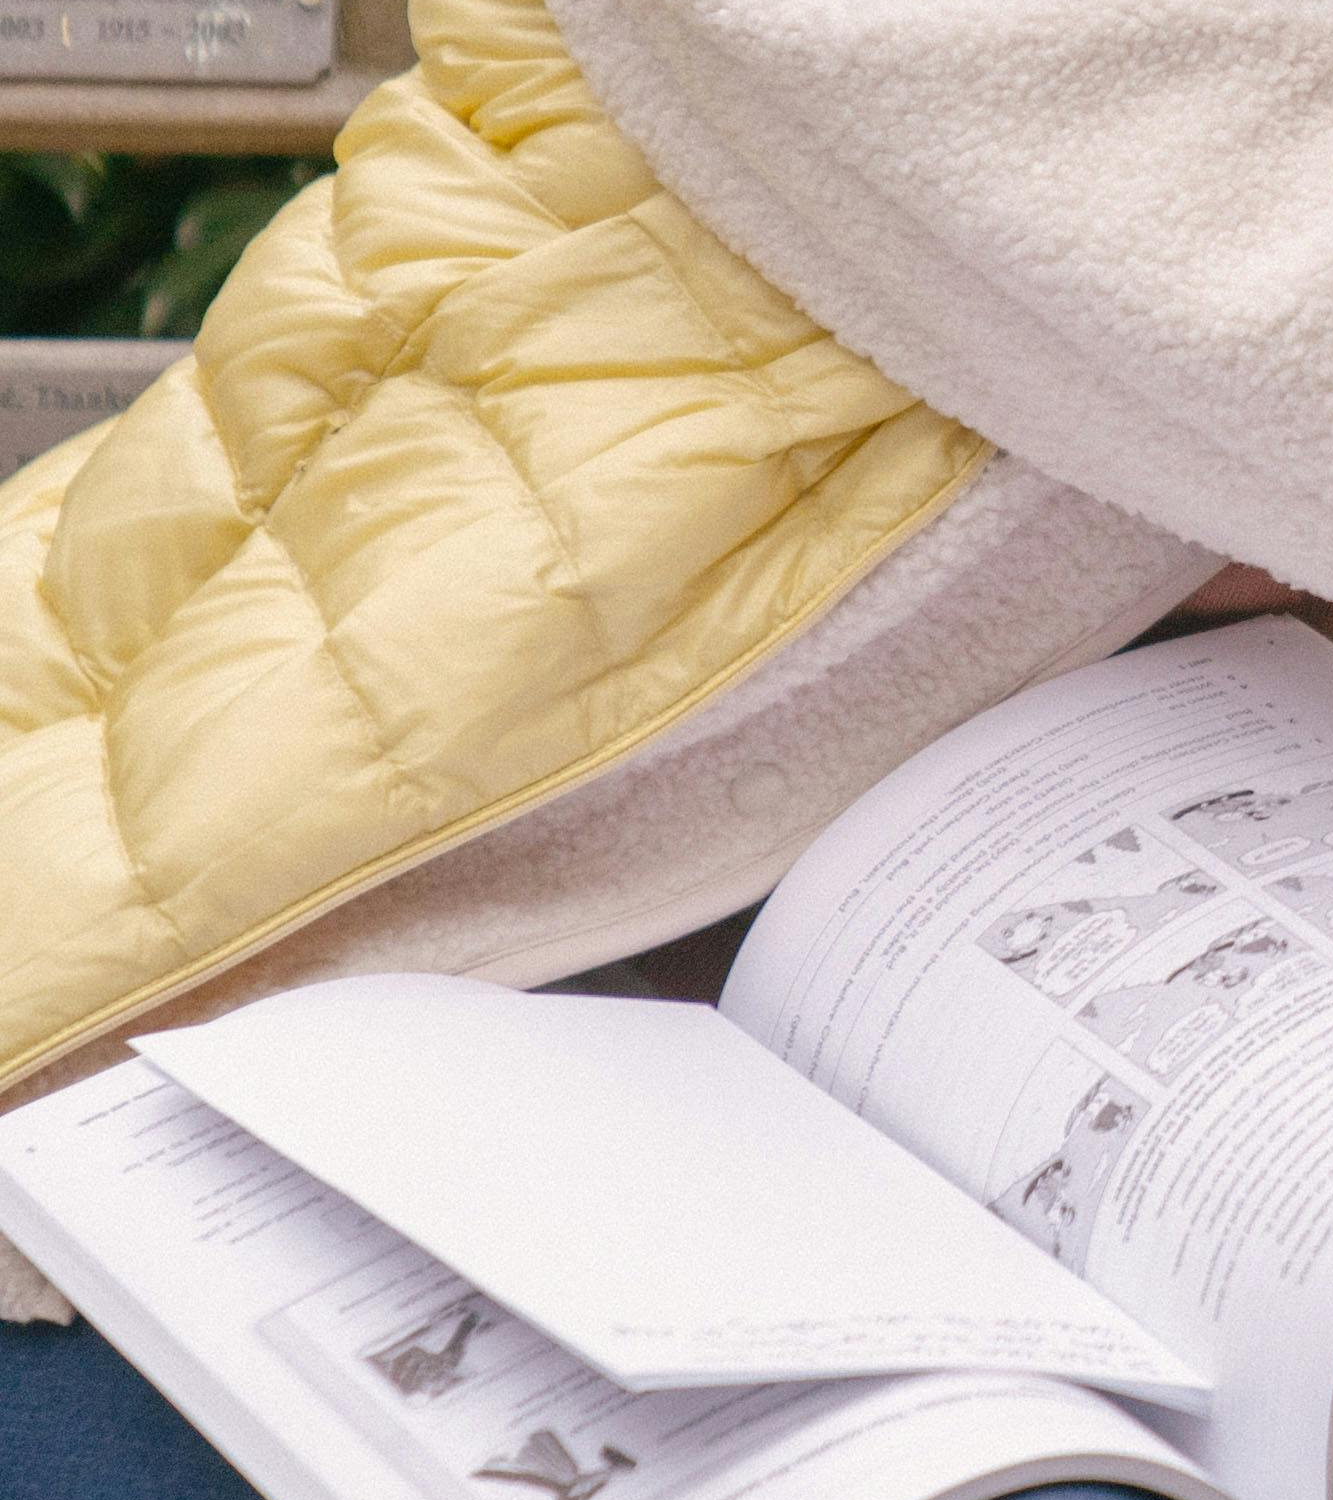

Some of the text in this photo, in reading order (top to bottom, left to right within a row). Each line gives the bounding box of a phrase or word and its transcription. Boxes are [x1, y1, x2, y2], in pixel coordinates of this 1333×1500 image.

[0, 15, 44, 40] 003
[1149, 686, 1165, 695] to
[1157, 693, 1174, 702] he
[1186, 689, 1225, 705] When
[1077, 691, 1147, 724] snowboard
[1168, 702, 1185, 711] he
[1043, 718, 1073, 738] with
[1231, 724, 1274, 741] Before
[982, 733, 1042, 772] Gretchen
[1139, 724, 1234, 761] snowboarding
[1168, 737, 1230, 763] Gretchen
[1030, 769, 1057, 787] him
[1100, 759, 1137, 781] down
[1014, 784, 1029, 796] to
[1076, 778, 1100, 793] the
[938, 786, 974, 815] down
[1013, 789, 1075, 831] mountain
[1018, 799, 1033, 812] to
[917, 813, 939, 832] the
[933, 792, 991, 837] Gretchen
[1069, 805, 1096, 824] him
[948, 808, 1017, 863] snowboard
[987, 829, 1012, 851] was
[1034, 832, 1053, 847] do
[1053, 822, 1068, 833] to
[1055, 808, 1120, 850] (consider)
[884, 857, 911, 883] Bud
[914, 860, 951, 894] down
[933, 847, 987, 894] probably
[973, 859, 991, 875] he
[933, 875, 975, 912] should
[968, 846, 1055, 918] snowboarding
[836, 886, 862, 914] Bud
[894, 893, 917, 916] the
[902, 904, 927, 929] bad
[916, 911, 935, 929] do
[848, 914, 897, 977] mountain
[879, 930, 906, 958] idea.
[937, 916, 971, 952] down
[884, 943, 909, 971] Bud
[919, 952, 940, 975] the
[825, 976, 855, 1022] before
[878, 976, 921, 1039] mountain
[805, 1024, 833, 1081] Gretche
